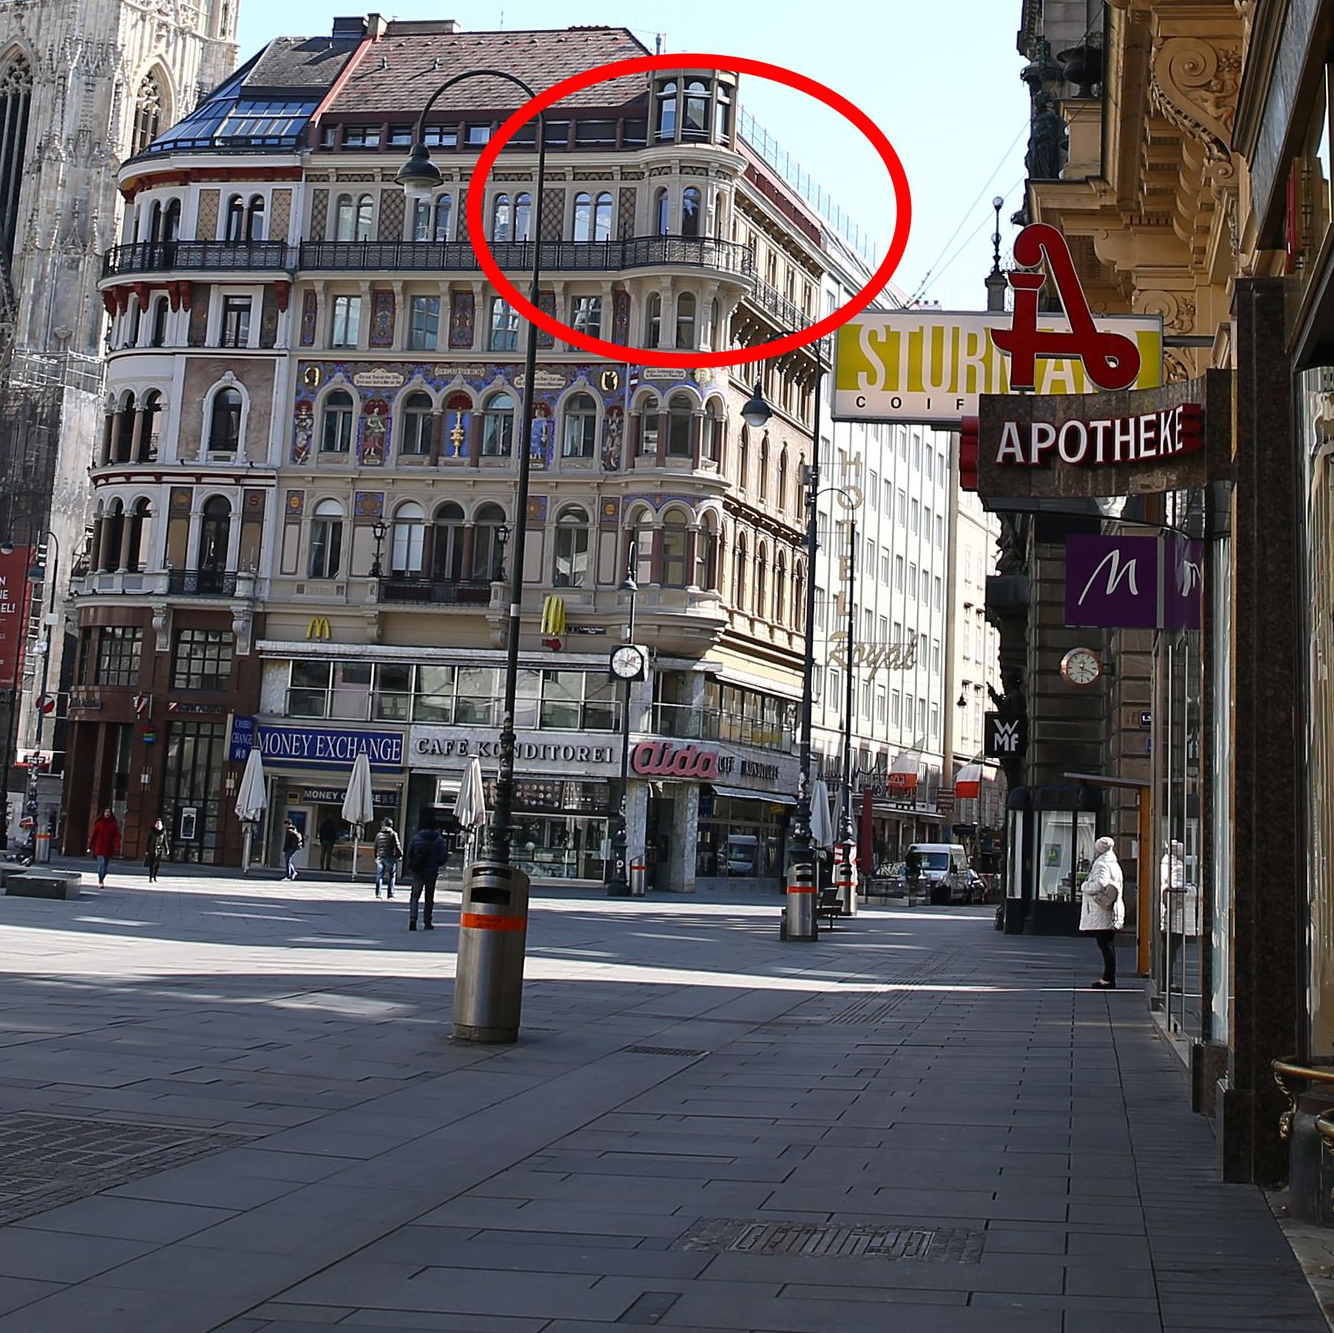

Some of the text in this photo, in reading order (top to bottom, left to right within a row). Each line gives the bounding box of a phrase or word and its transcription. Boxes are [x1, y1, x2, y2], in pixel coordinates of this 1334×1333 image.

[855, 395, 965, 412] COIF
[995, 404, 1184, 465] APOTHEKE
[836, 451, 863, 617] HOTEL
[827, 631, 919, 682] Royal
[257, 732, 313, 756] MONEY
[317, 735, 401, 762] EXCHANGE
[303, 790, 339, 800] MONEY
